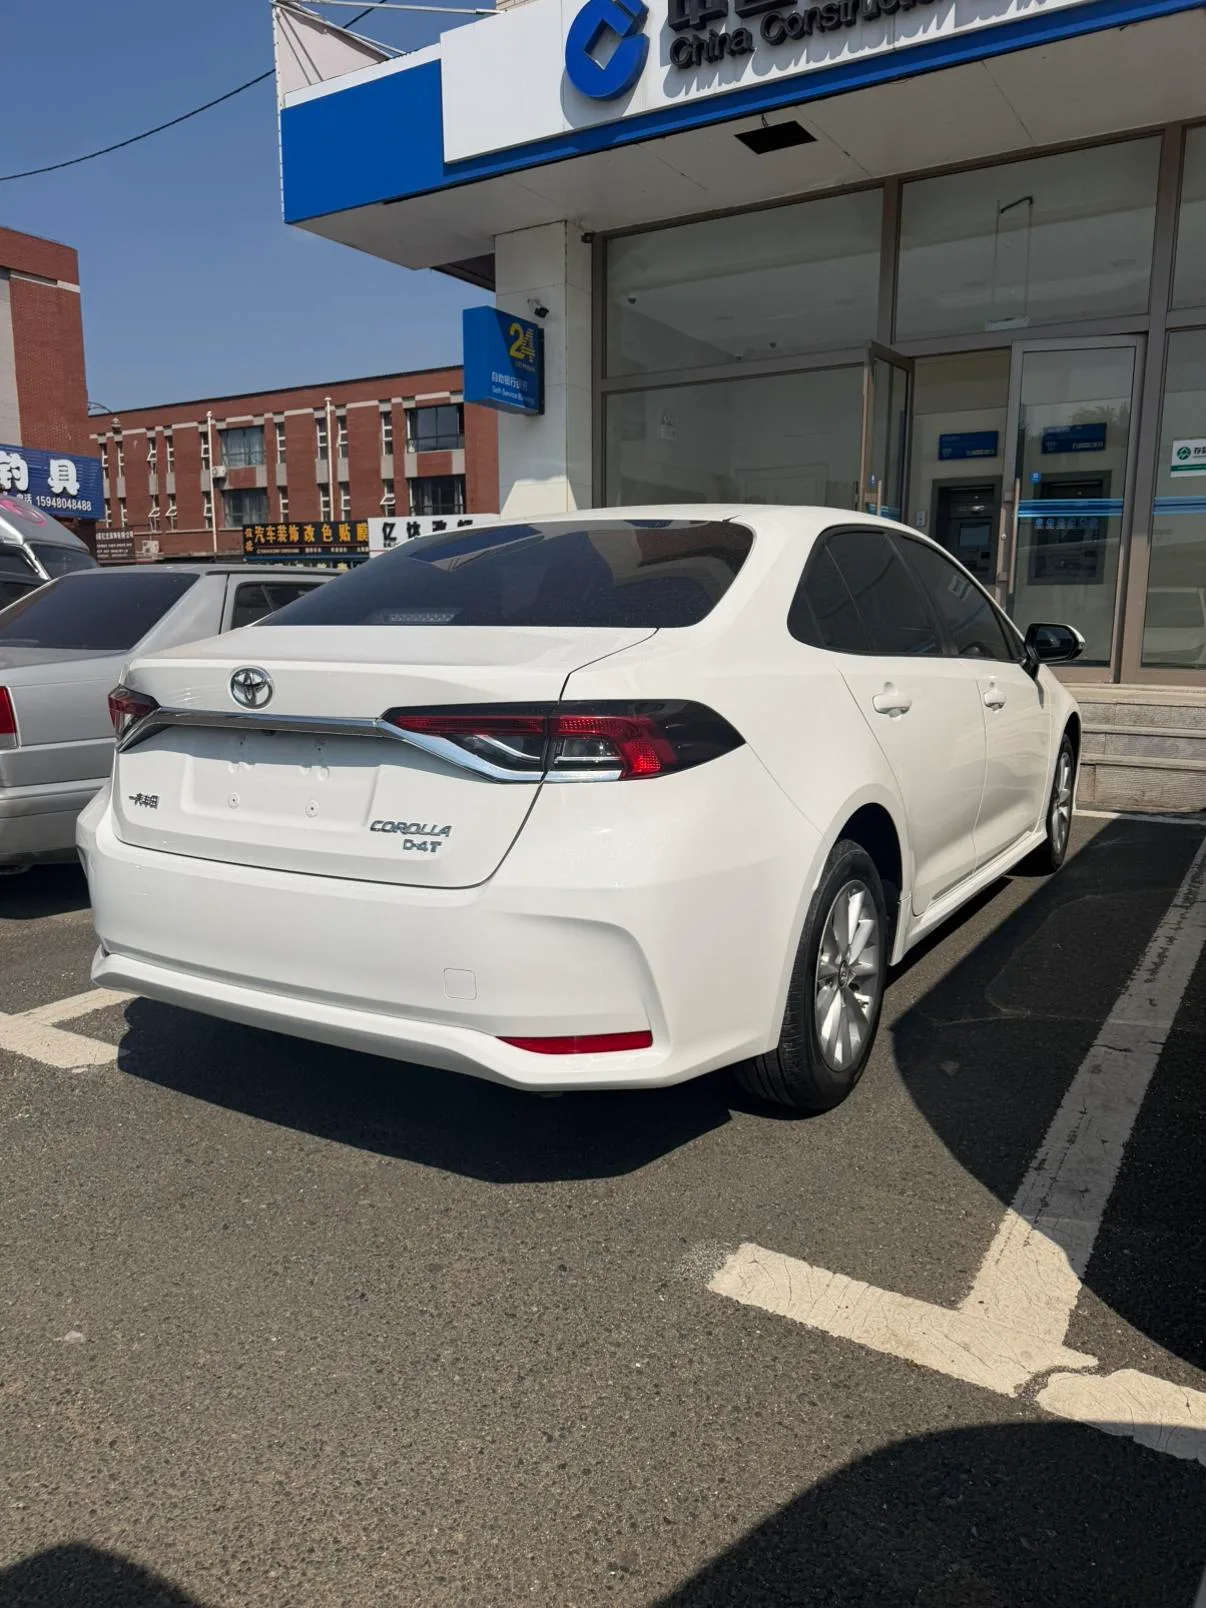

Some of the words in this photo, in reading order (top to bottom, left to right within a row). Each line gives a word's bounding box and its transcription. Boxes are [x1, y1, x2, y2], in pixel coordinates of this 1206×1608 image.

[669, 27, 754, 69] China
[760, 0, 938, 46] Constru
[36, 496, 92, 511] 15948048488
[370, 820, 452, 837] COROLLA
